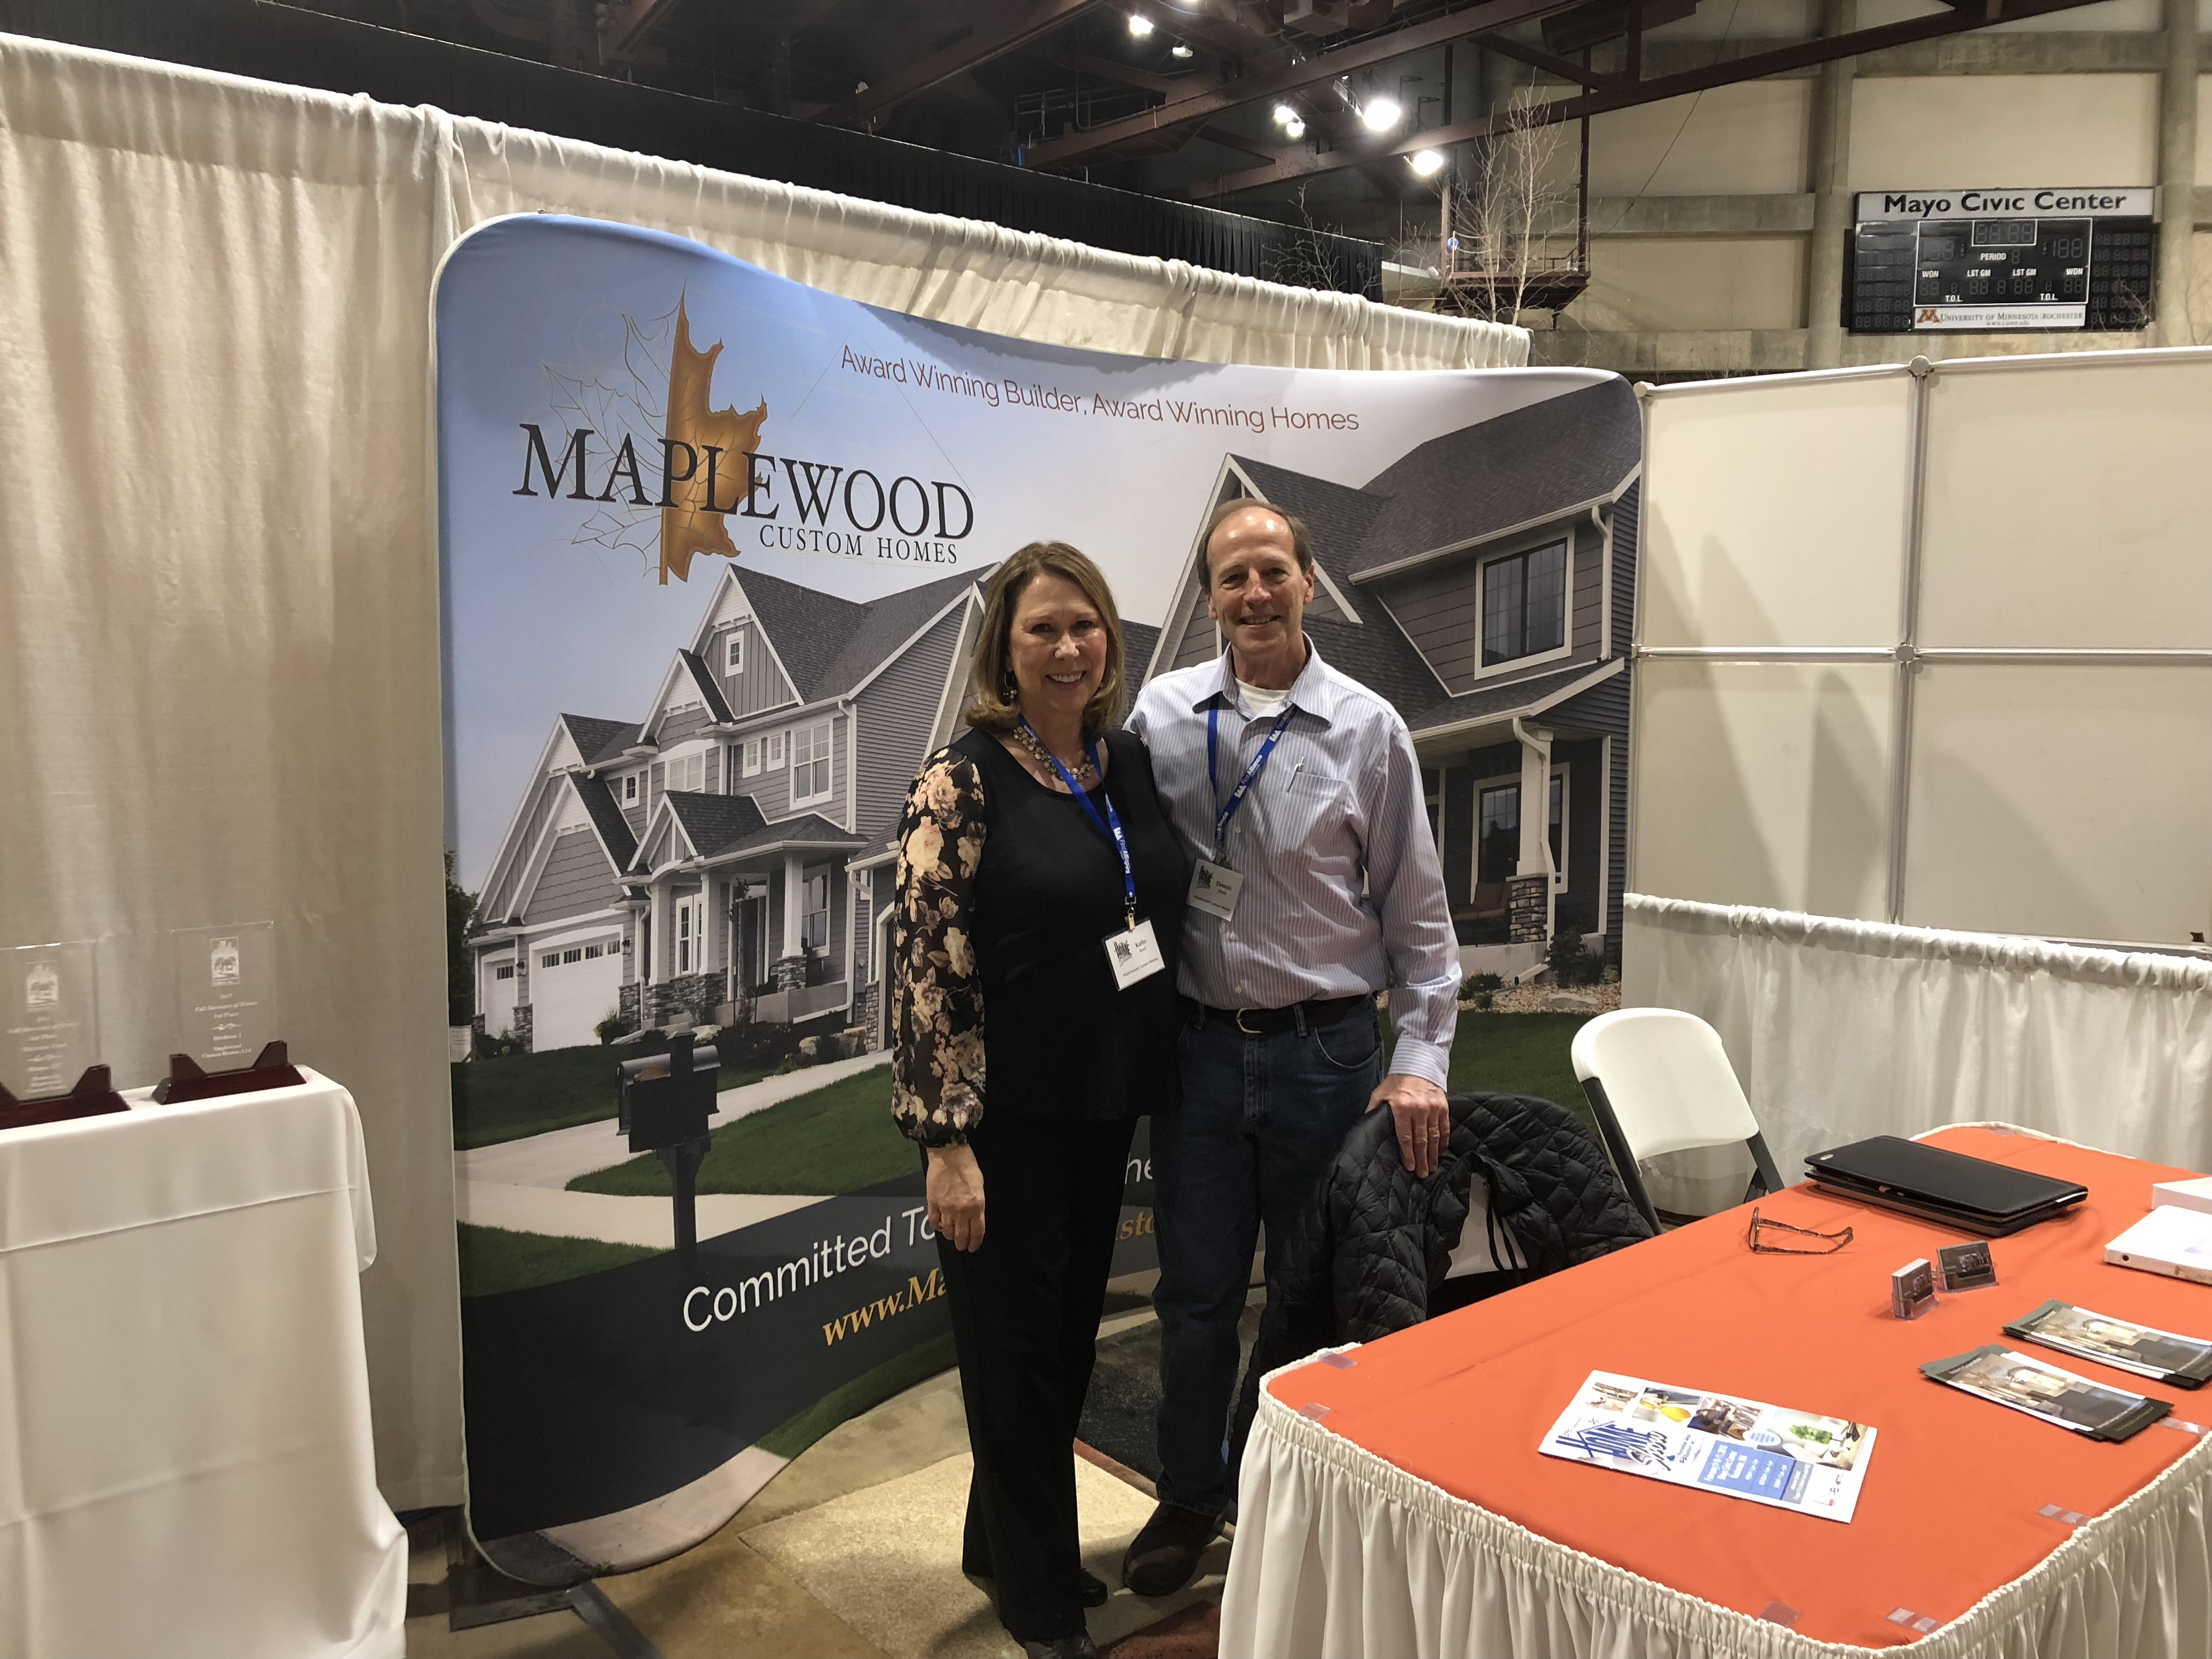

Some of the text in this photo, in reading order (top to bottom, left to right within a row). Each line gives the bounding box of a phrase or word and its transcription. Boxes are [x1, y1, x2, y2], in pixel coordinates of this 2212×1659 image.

[1883, 194, 1951, 218] Mayo
[2034, 191, 2128, 211] Center
[1980, 252, 2007, 261] PERIOD
[1922, 267, 2084, 278] WON LST GM LST GM WON
[1940, 313, 1983, 321] UNIVERSITY
[1996, 312, 2039, 320] MINNESOTA
[841, 345, 1359, 433] Award Winning Builder, Award Winning Homes
[512, 423, 974, 539] MAPLEWOOD
[760, 525, 958, 565] CUSTOM HOMES
[1135, 939, 1147, 948] Kathy
[683, 1215, 893, 1333] Committed
